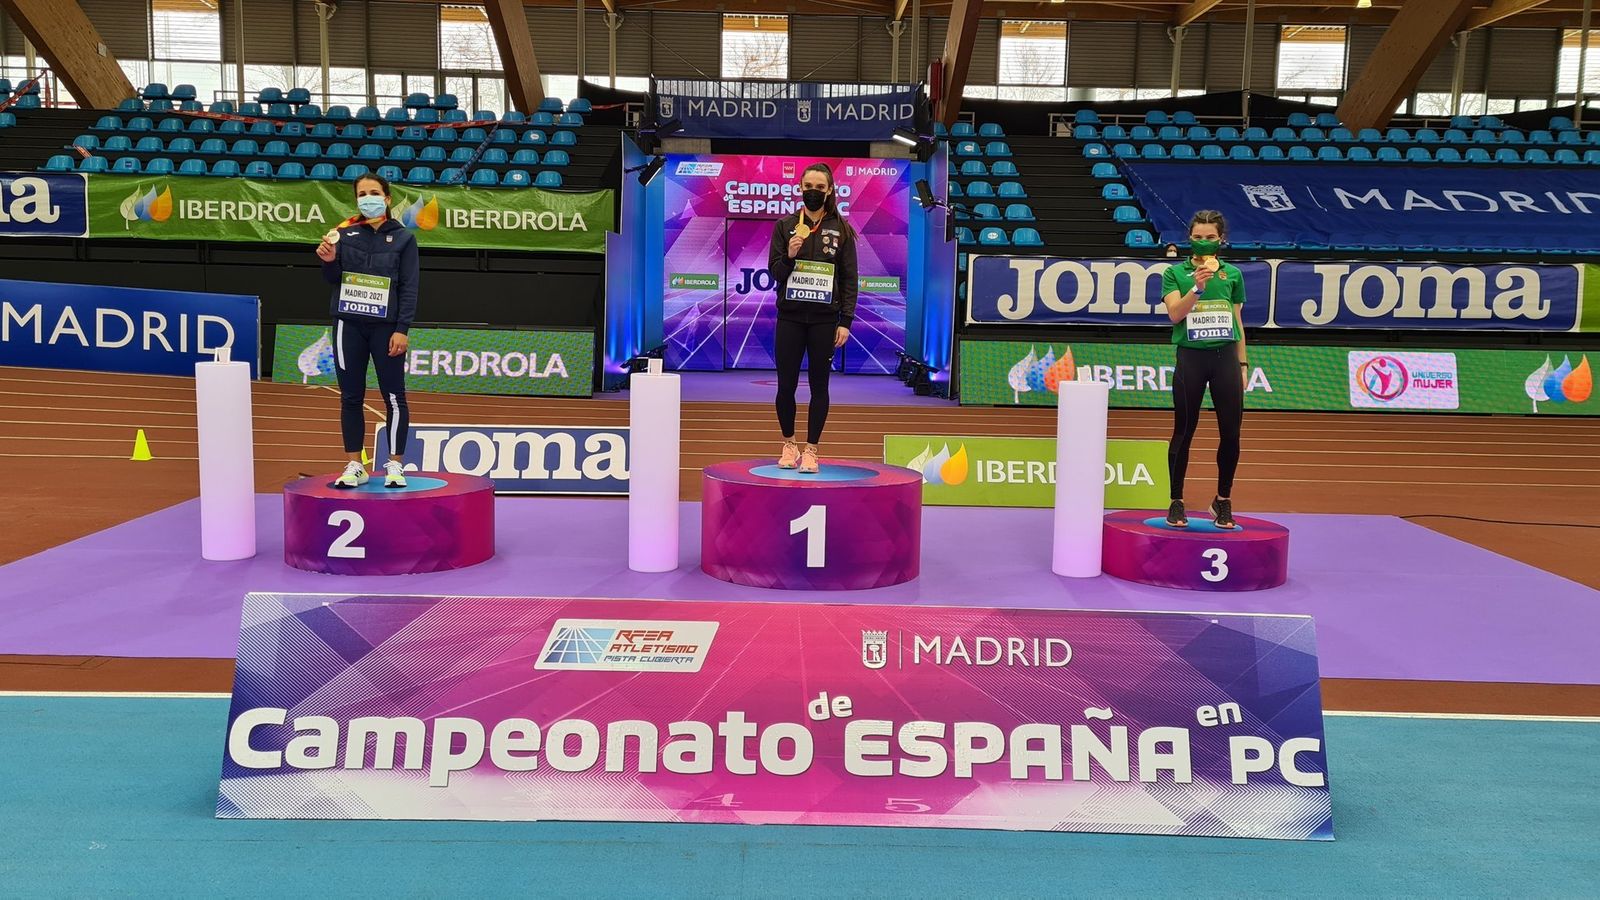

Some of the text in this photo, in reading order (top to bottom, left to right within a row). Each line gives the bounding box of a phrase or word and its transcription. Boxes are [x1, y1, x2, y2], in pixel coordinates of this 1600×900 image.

[688, 100, 777, 119] MADRID
[826, 103, 915, 121] MADRID
[858, 167, 898, 176] MADRID
[179, 199, 326, 223] IBERDROLA
[445, 208, 588, 232] IBERDROLA
[736, 267, 777, 295] Jo
[792, 276, 829, 287] MADRID 2021
[997, 259, 1173, 320] Jom
[345, 288, 383, 301] MADRID 2021
[1301, 263, 1550, 325] Joma
[2, 301, 235, 355] MADRID
[1192, 315, 1230, 325] MADRID 2021
[404, 349, 569, 379] ERDROLA
[1093, 364, 1273, 393] BERDA
[1413, 379, 1454, 389] MUJER
[976, 459, 1155, 486] IBERLA
[327, 510, 365, 559] 2
[789, 504, 827, 568] 1
[1200, 547, 1230, 582] 3
[609, 643, 699, 654] ATLETISMO
[615, 629, 674, 644] RFEA
[603, 655, 694, 665] PISTA CUBIERTA
[913, 635, 1073, 667] MADRID
[228, 691, 1324, 788] Campeonato de ESPAÑA en PC
